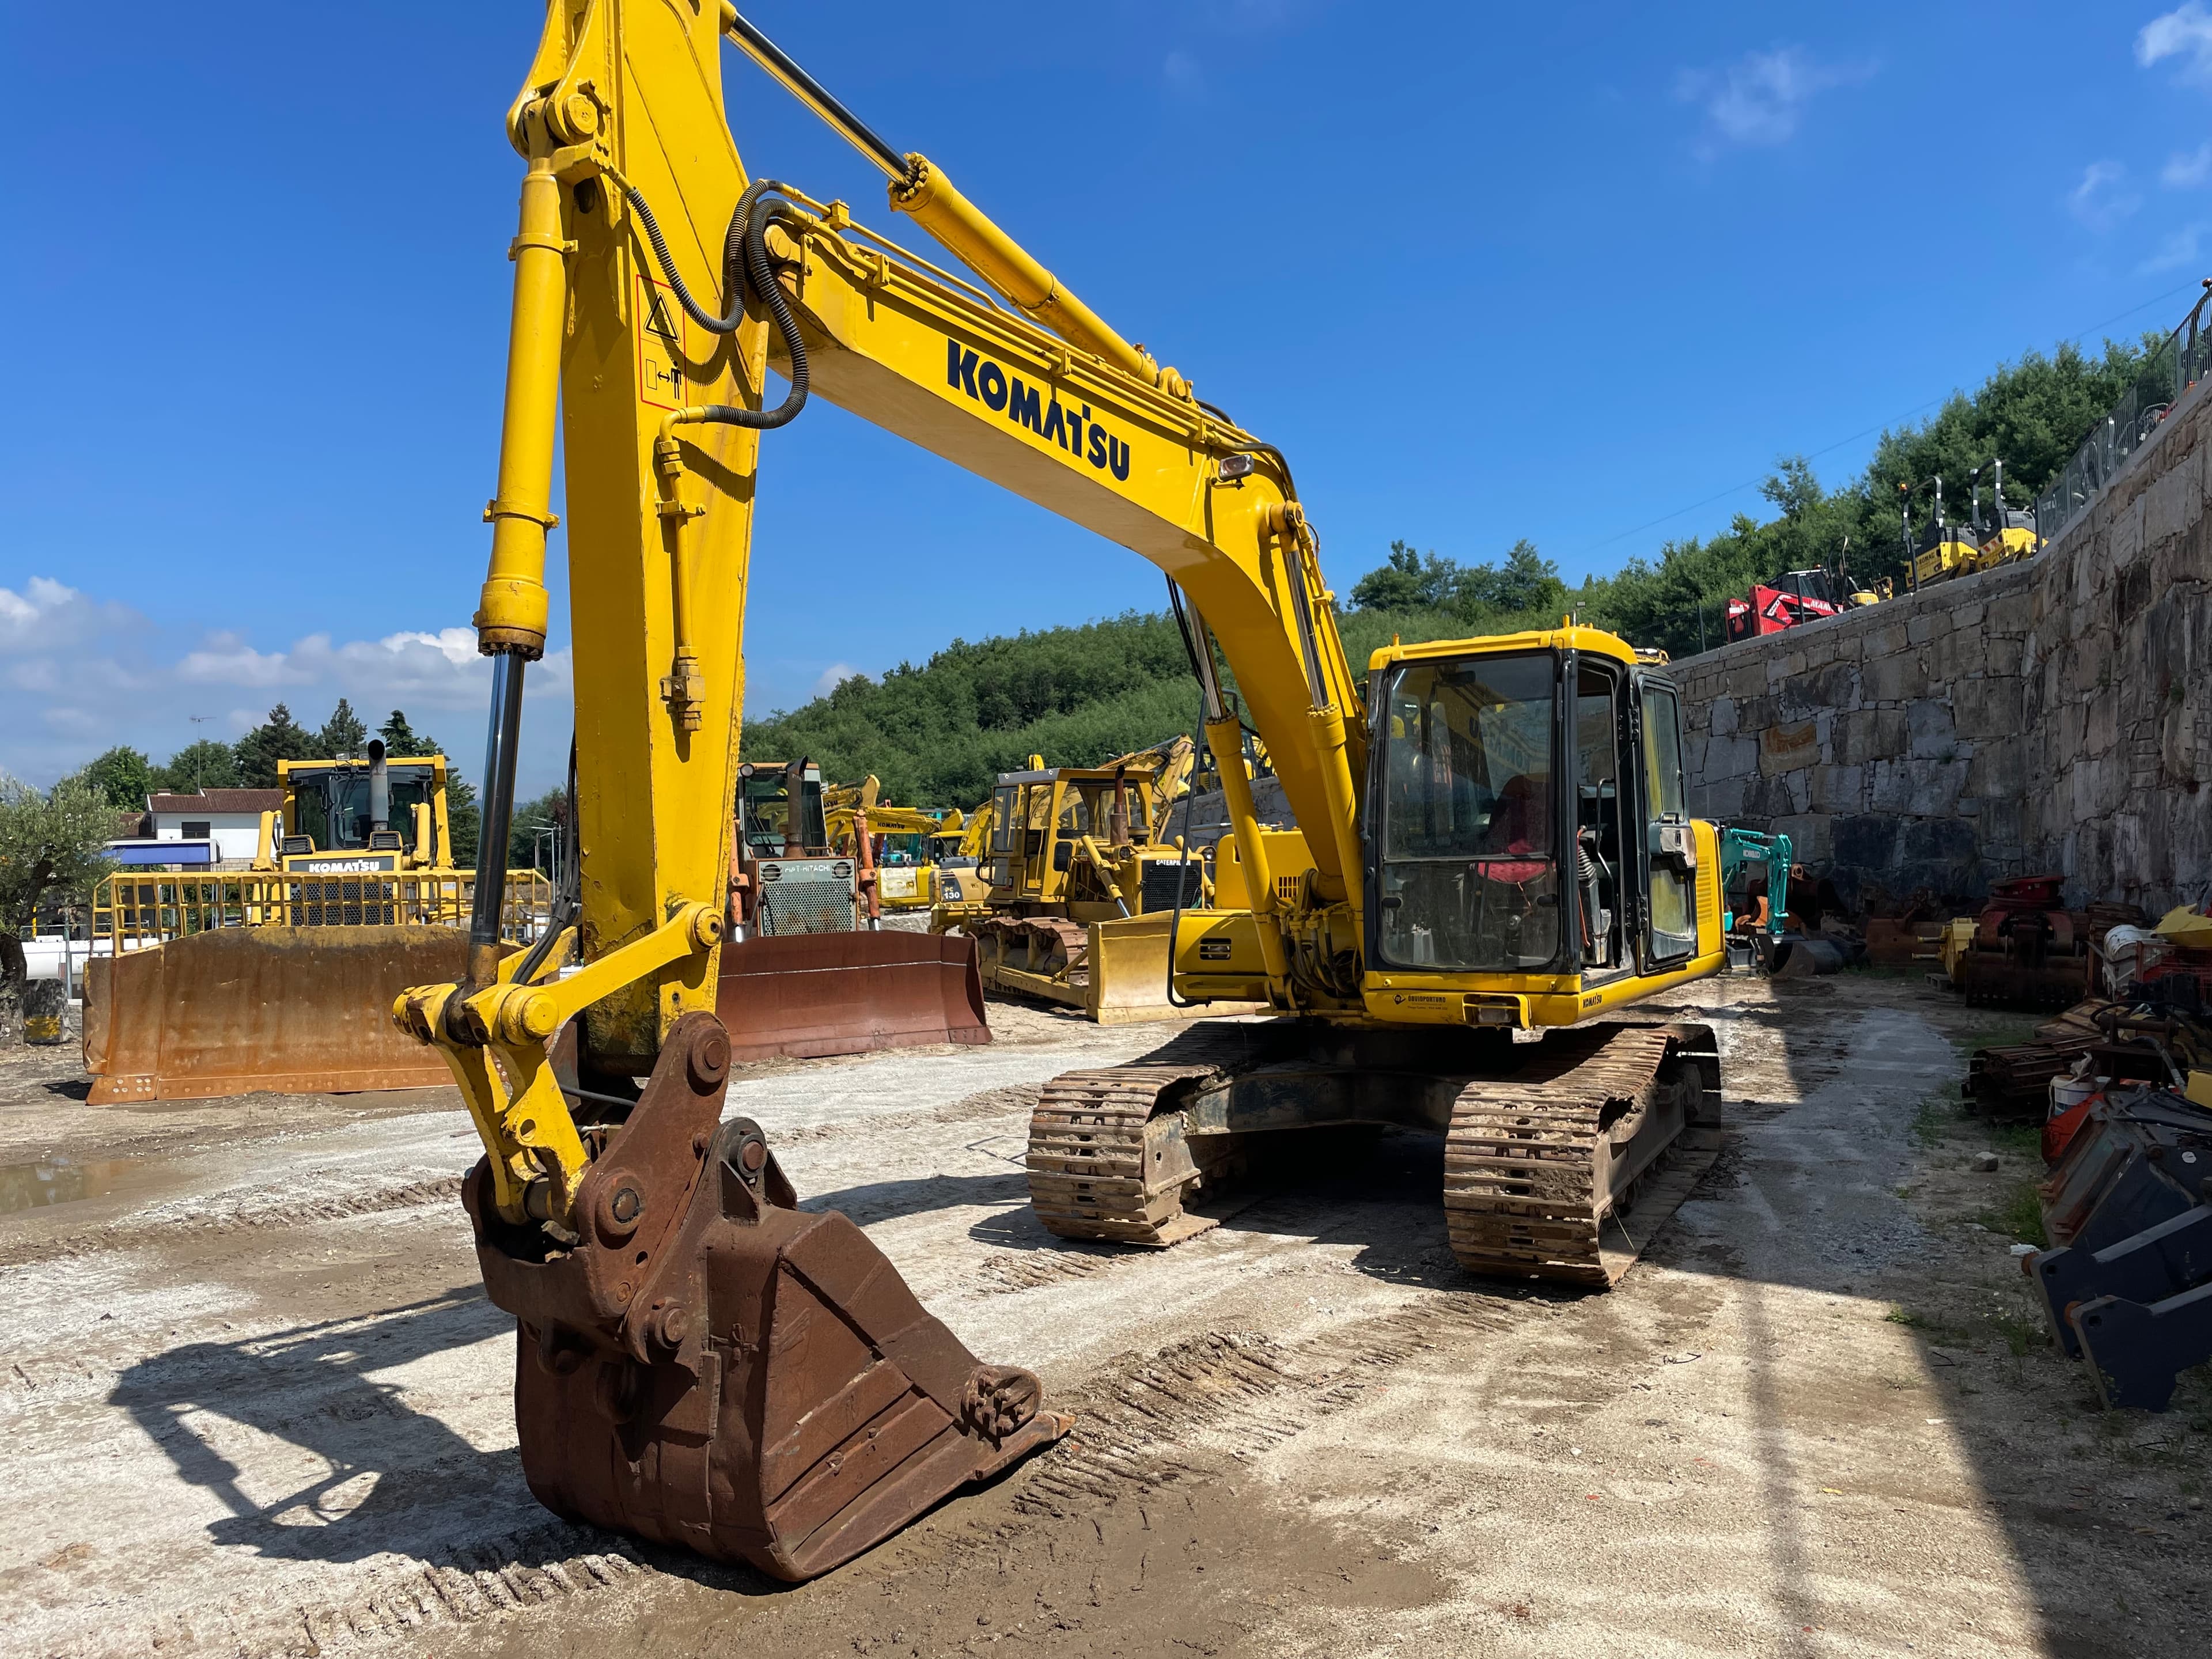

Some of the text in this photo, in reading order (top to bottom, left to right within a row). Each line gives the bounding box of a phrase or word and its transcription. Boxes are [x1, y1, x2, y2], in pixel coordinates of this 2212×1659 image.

[948, 338, 1130, 481] KOMATSU
[309, 859, 380, 873] KOMATSU
[1583, 992, 1602, 1009] KOMATSU
